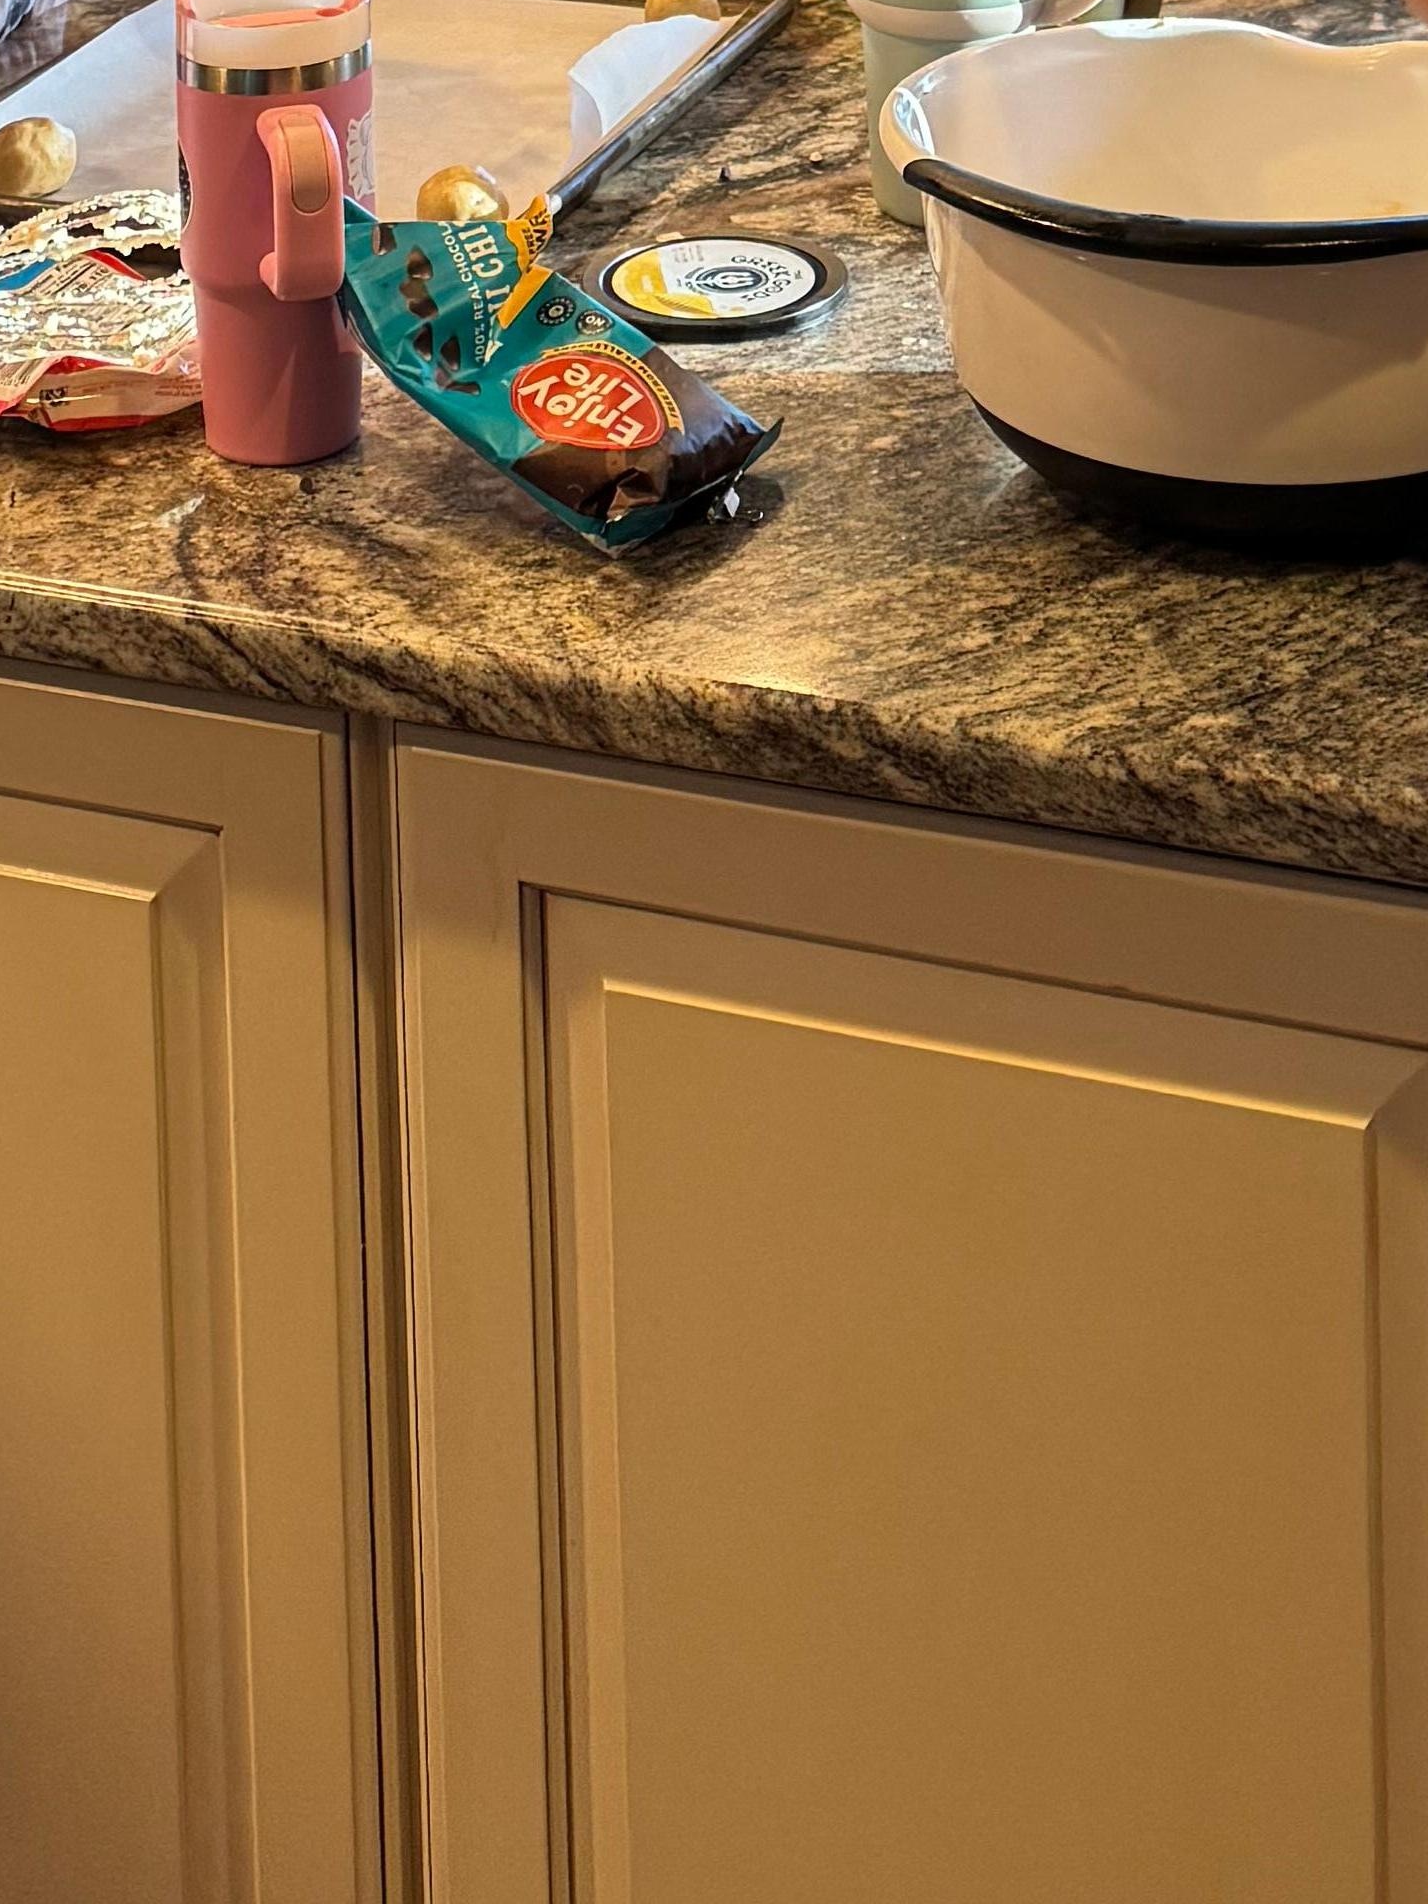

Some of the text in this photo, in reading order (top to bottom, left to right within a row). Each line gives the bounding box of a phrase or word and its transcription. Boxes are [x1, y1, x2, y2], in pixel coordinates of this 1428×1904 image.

[453, 220, 504, 279] CHI
[467, 281, 485, 321] REAL
[517, 375, 645, 449] Enjoy
[563, 362, 644, 413] Life
